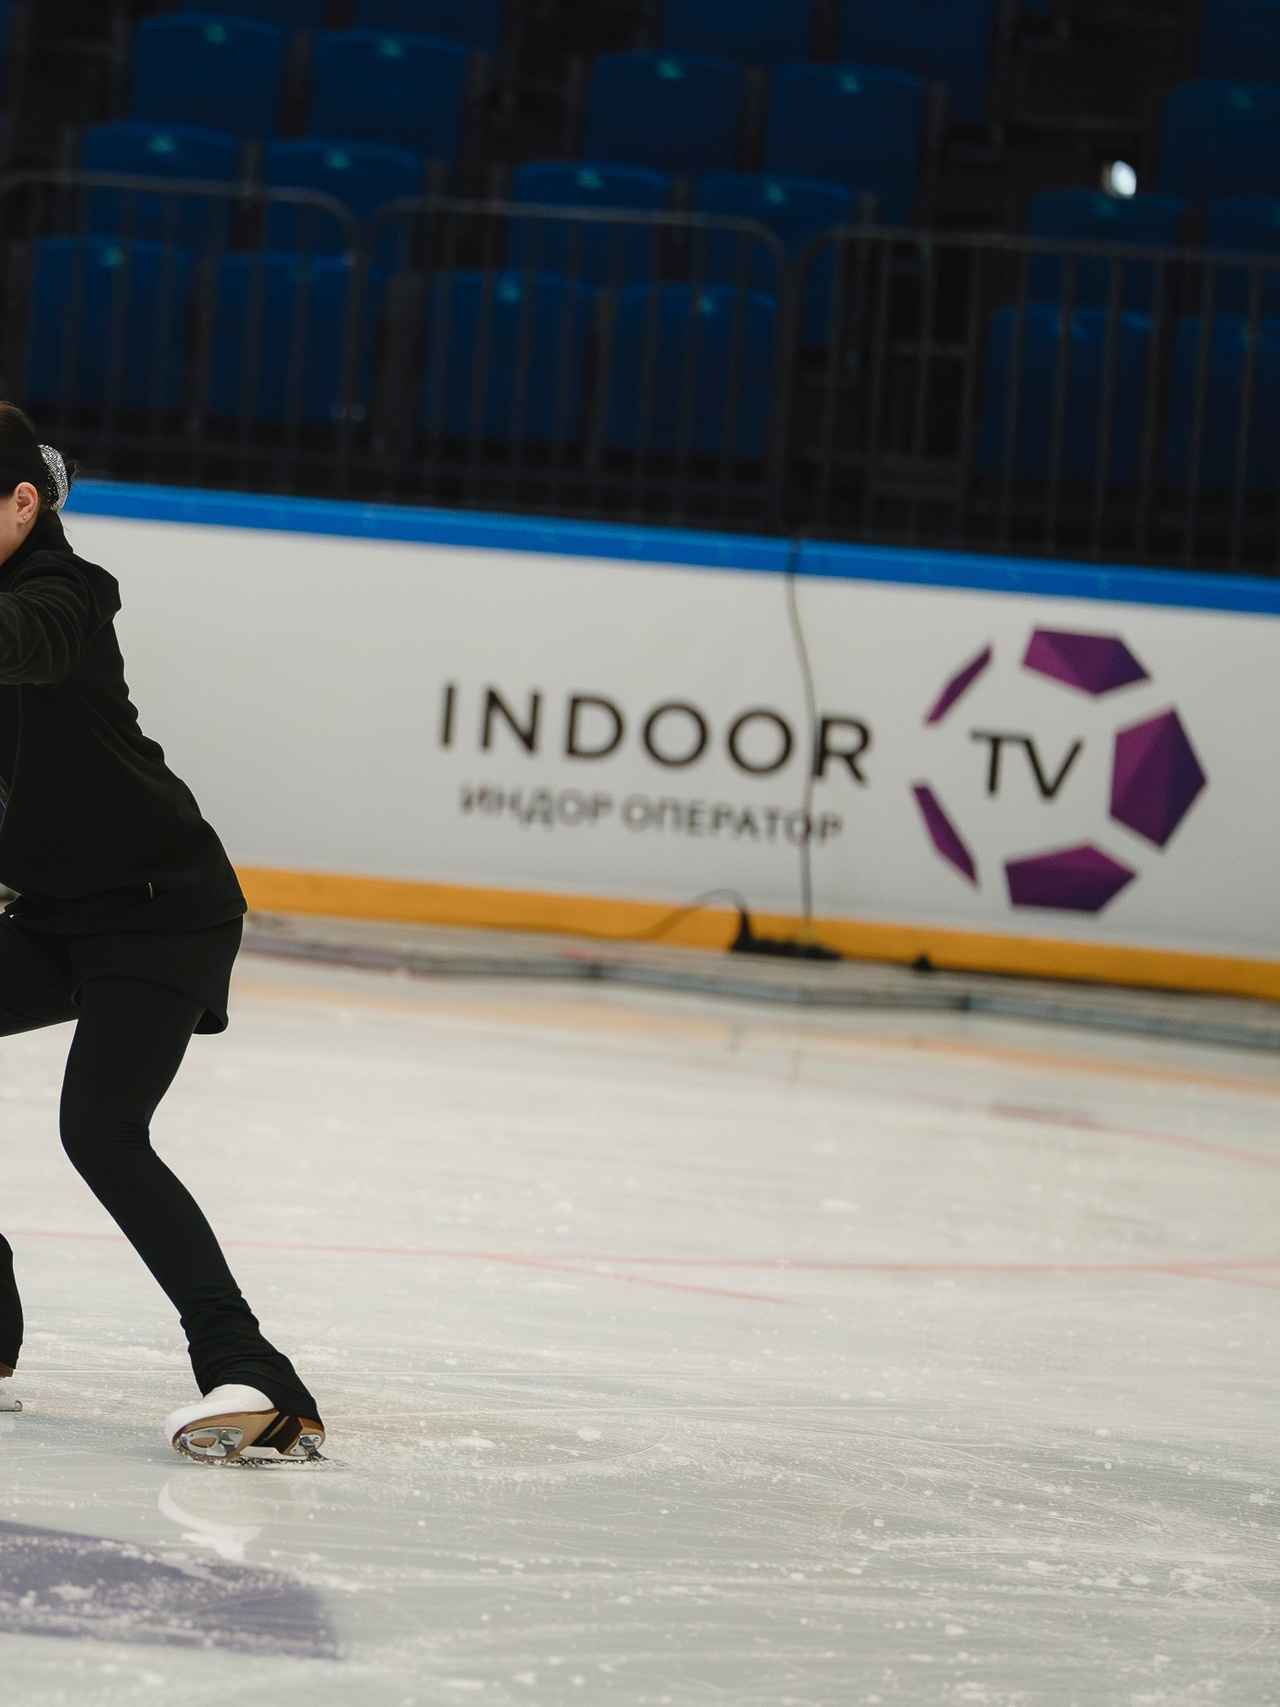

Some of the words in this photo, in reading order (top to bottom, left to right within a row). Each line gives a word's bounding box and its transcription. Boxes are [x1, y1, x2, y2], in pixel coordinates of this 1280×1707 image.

[439, 681, 873, 784] INDOOR
[971, 727, 1085, 800] TV
[459, 782, 613, 832] ИНДОР
[622, 792, 844, 845] ОПЕРАТОР
